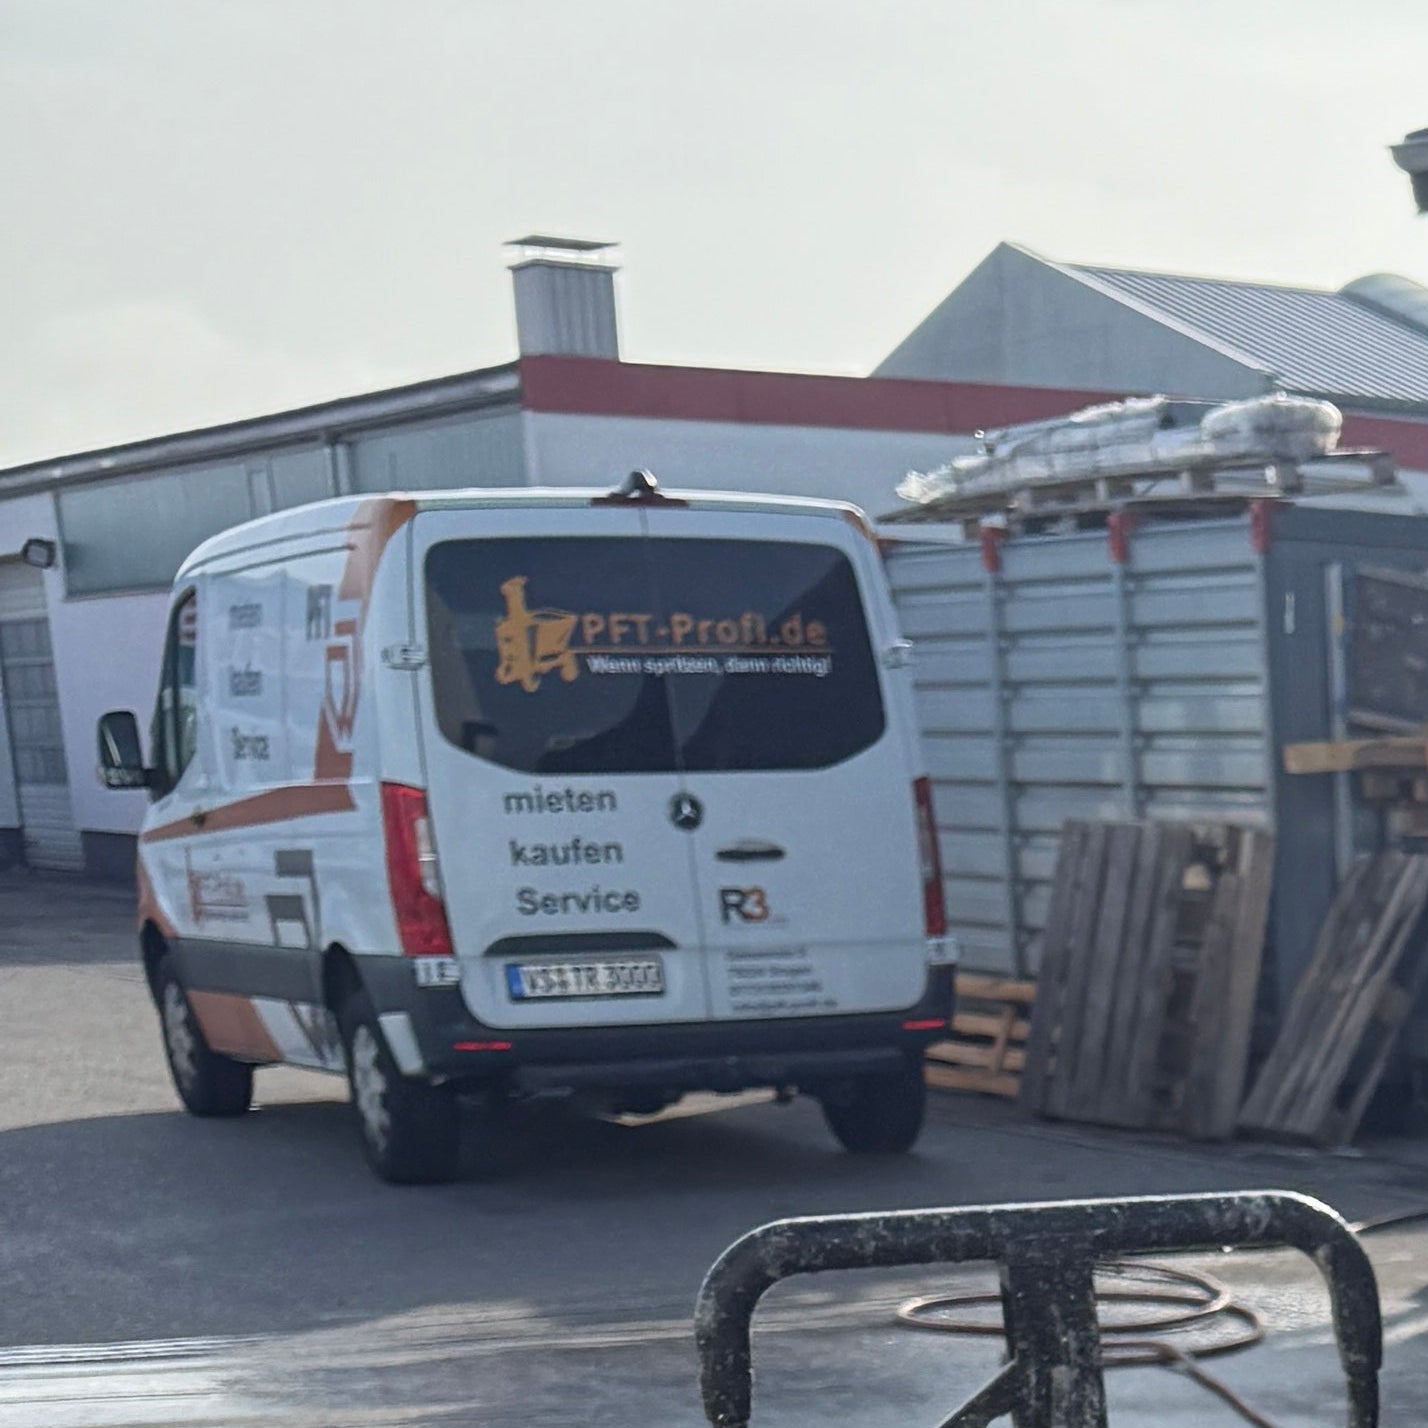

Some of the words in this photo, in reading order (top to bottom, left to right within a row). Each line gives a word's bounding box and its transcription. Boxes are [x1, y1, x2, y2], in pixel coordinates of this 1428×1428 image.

[582, 612, 828, 645] PFT-Profi.de
[587, 656, 641, 674] Wenn
[643, 655, 720, 677] spritzen,
[724, 655, 768, 674] dann
[504, 785, 617, 813] mieten
[509, 838, 624, 866] kaufen
[516, 885, 642, 916] Service
[720, 886, 770, 924] R3
